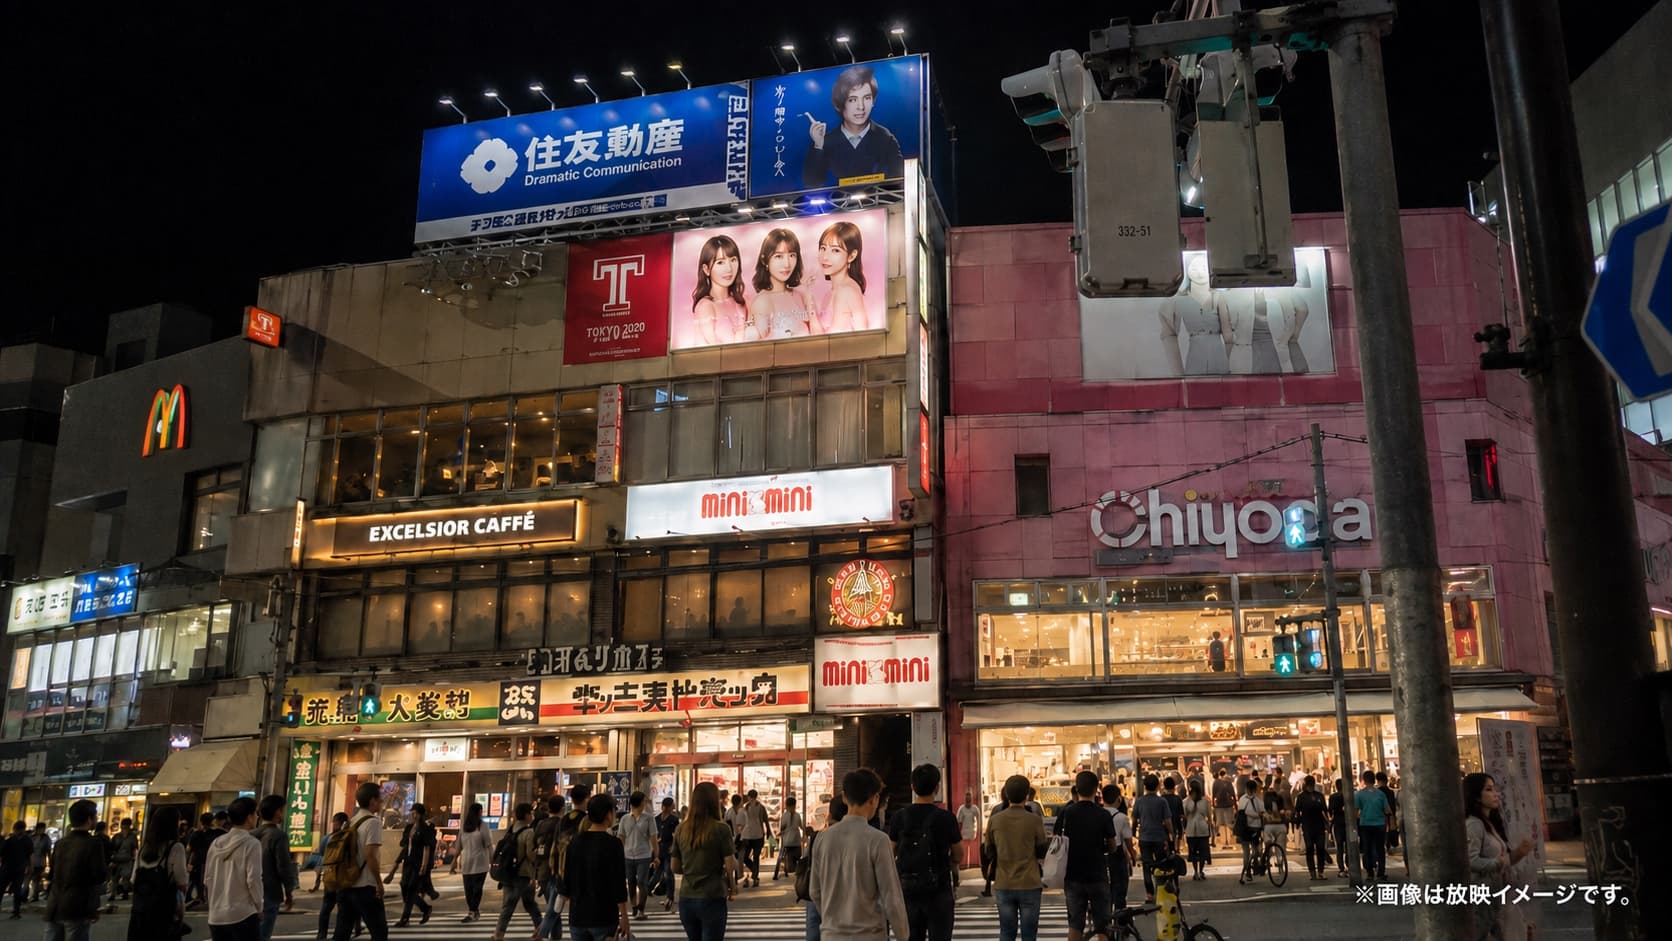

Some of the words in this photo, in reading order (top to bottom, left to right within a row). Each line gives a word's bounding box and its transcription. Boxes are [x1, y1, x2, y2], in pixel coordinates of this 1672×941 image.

[524, 169, 580, 186] Dramatic
[583, 156, 682, 178] Communication
[1118, 225, 1151, 237] 332-51
[587, 325, 620, 340] TOKYO
[622, 321, 645, 339] 2020
[701, 490, 747, 519] mini
[765, 485, 812, 514] mini
[369, 519, 469, 542] EXCELSIOR
[474, 510, 536, 534] CAFFÉ
[822, 660, 867, 687] mini
[884, 656, 929, 684] mini
